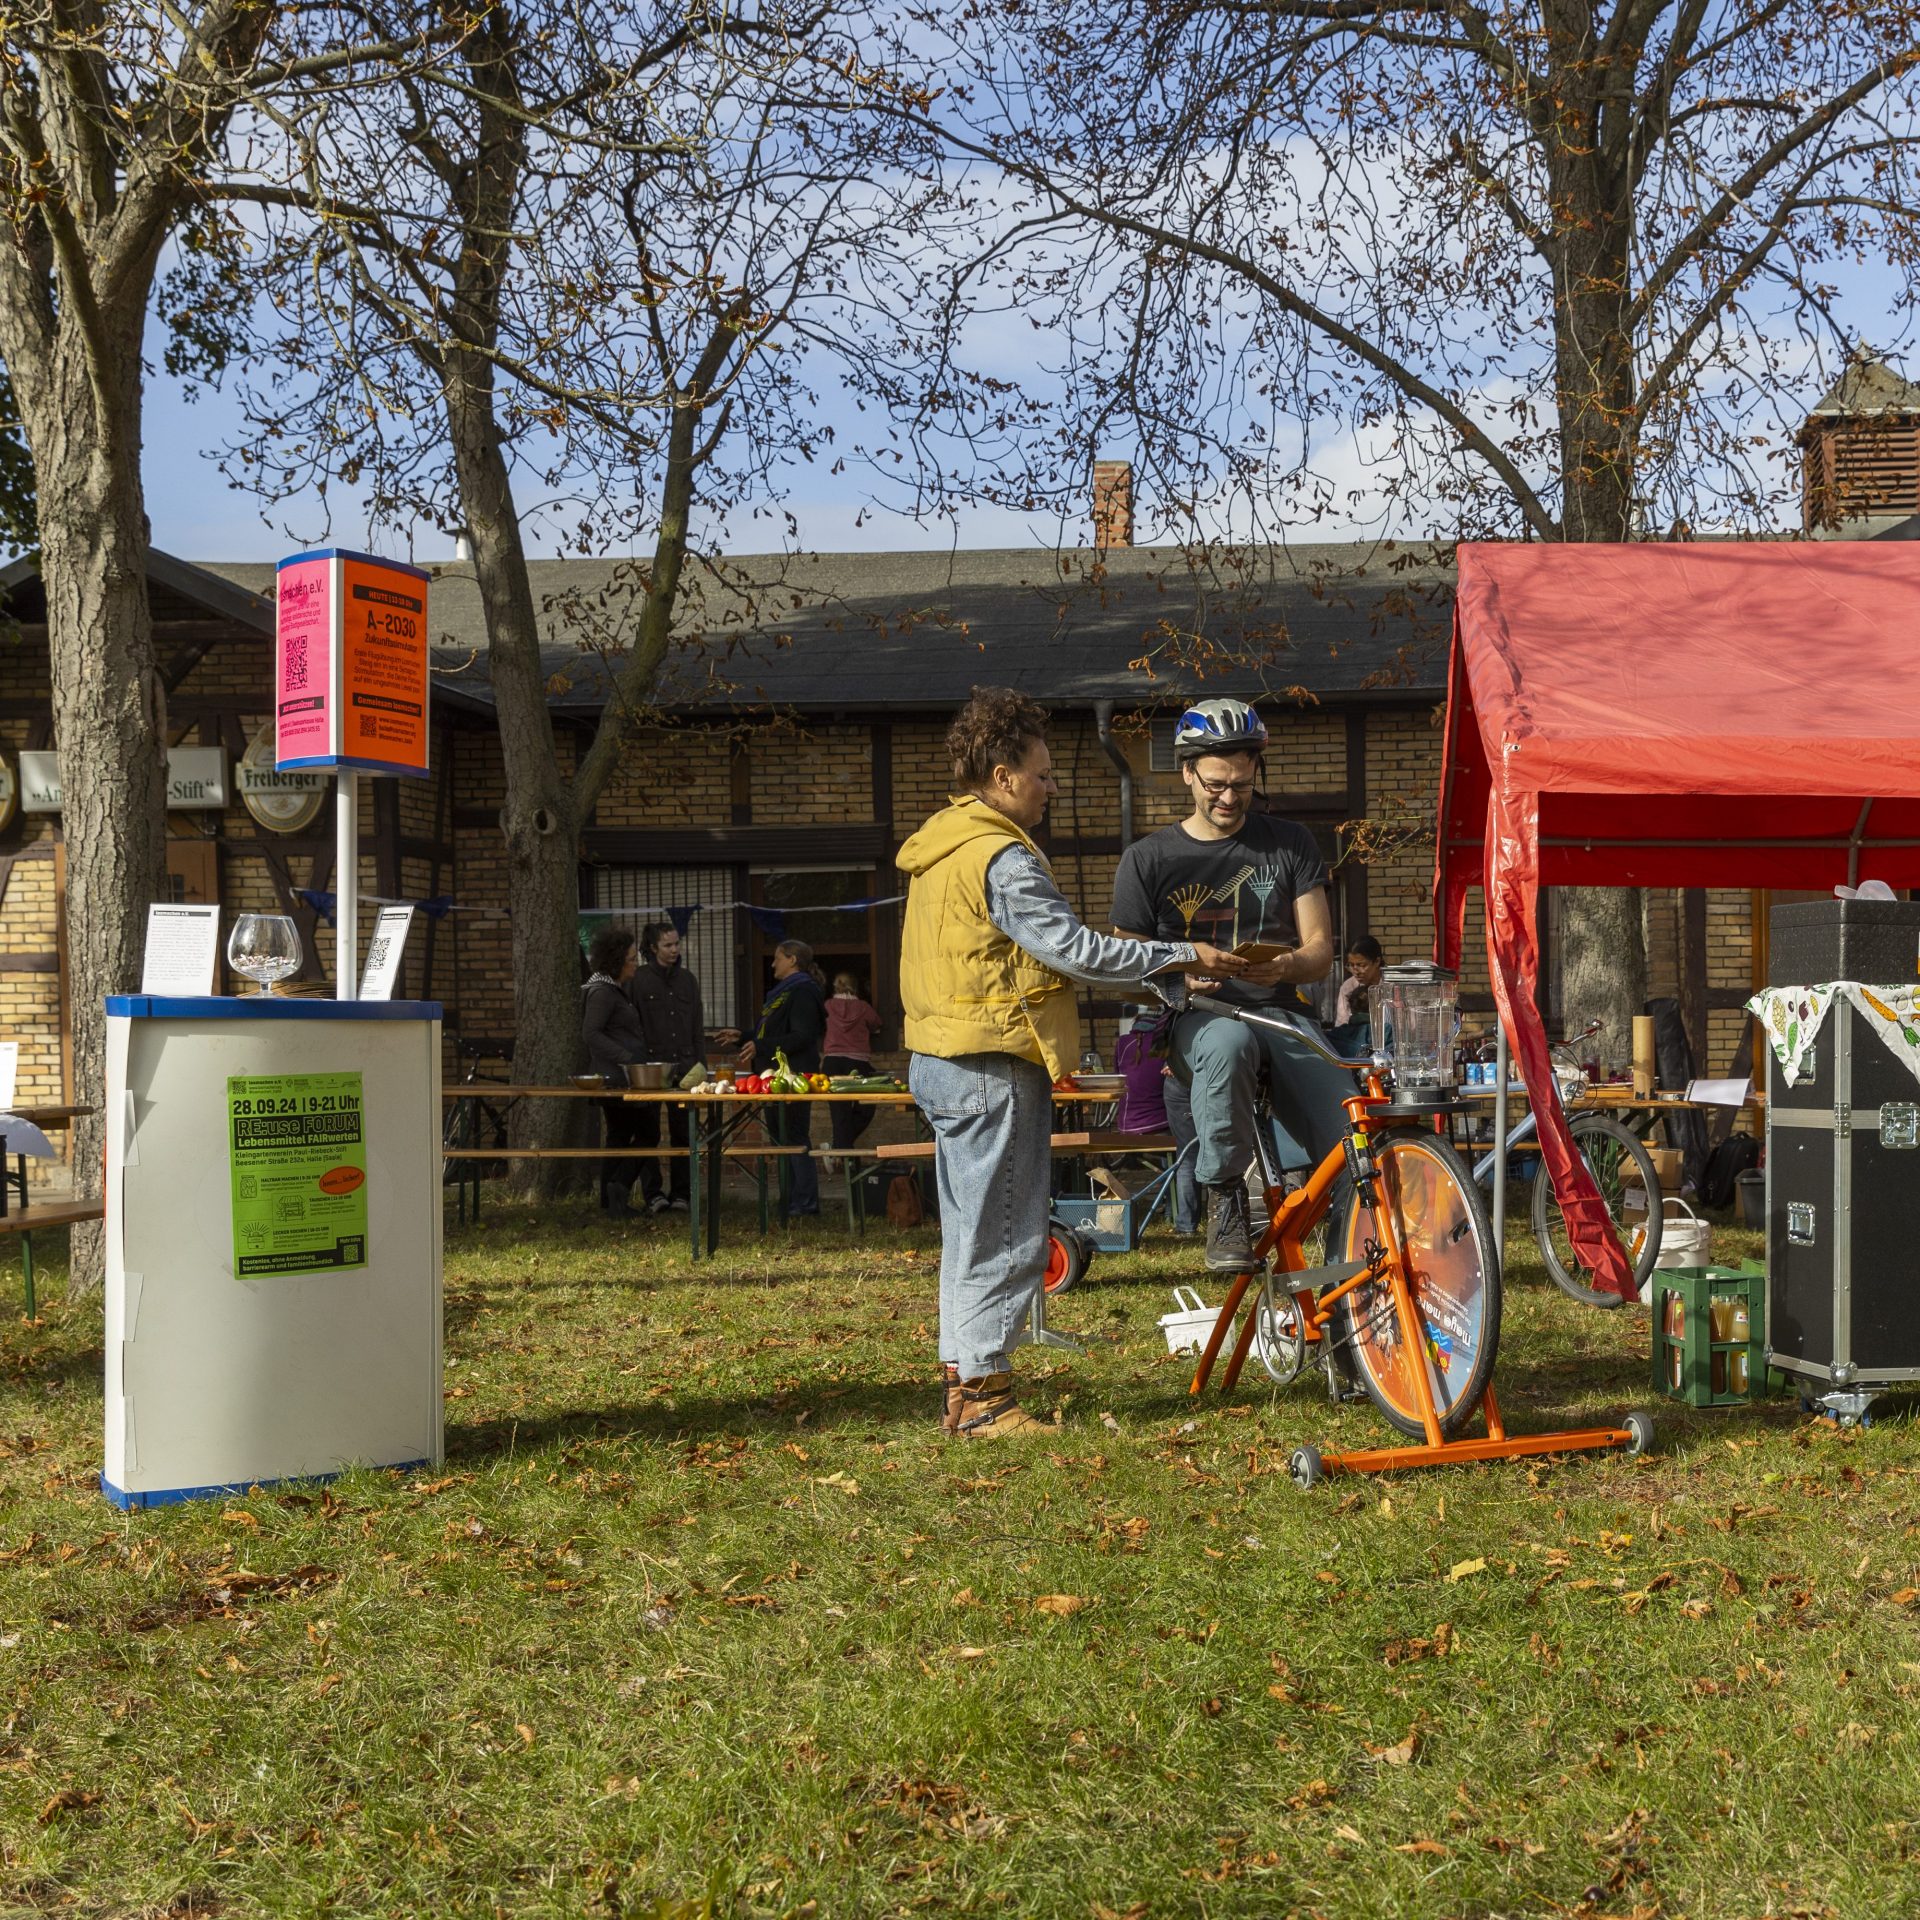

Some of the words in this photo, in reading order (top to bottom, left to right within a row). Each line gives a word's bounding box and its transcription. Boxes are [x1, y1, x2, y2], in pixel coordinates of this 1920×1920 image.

[310, 579, 323, 593] e.V.
[367, 609, 416, 639] A-2030
[357, 696, 393, 709] Gemeinsam
[244, 768, 318, 790] Freiberger
[233, 1098, 297, 1116] 28.09.24
[309, 1096, 336, 1112] 9-21
[338, 1095, 360, 1110] Uhr
[237, 1119, 301, 1137] RE:use
[302, 1113, 359, 1134] FORUM
[238, 1134, 306, 1148] Lebensmittel
[307, 1132, 359, 1144] FAIRwerten
[235, 1149, 293, 1160] Kleingartenverein
[235, 1158, 267, 1167] Beesener
[268, 1157, 289, 1165] Straße
[307, 1155, 322, 1163] Halle
[242, 1263, 276, 1271] barrierearm
